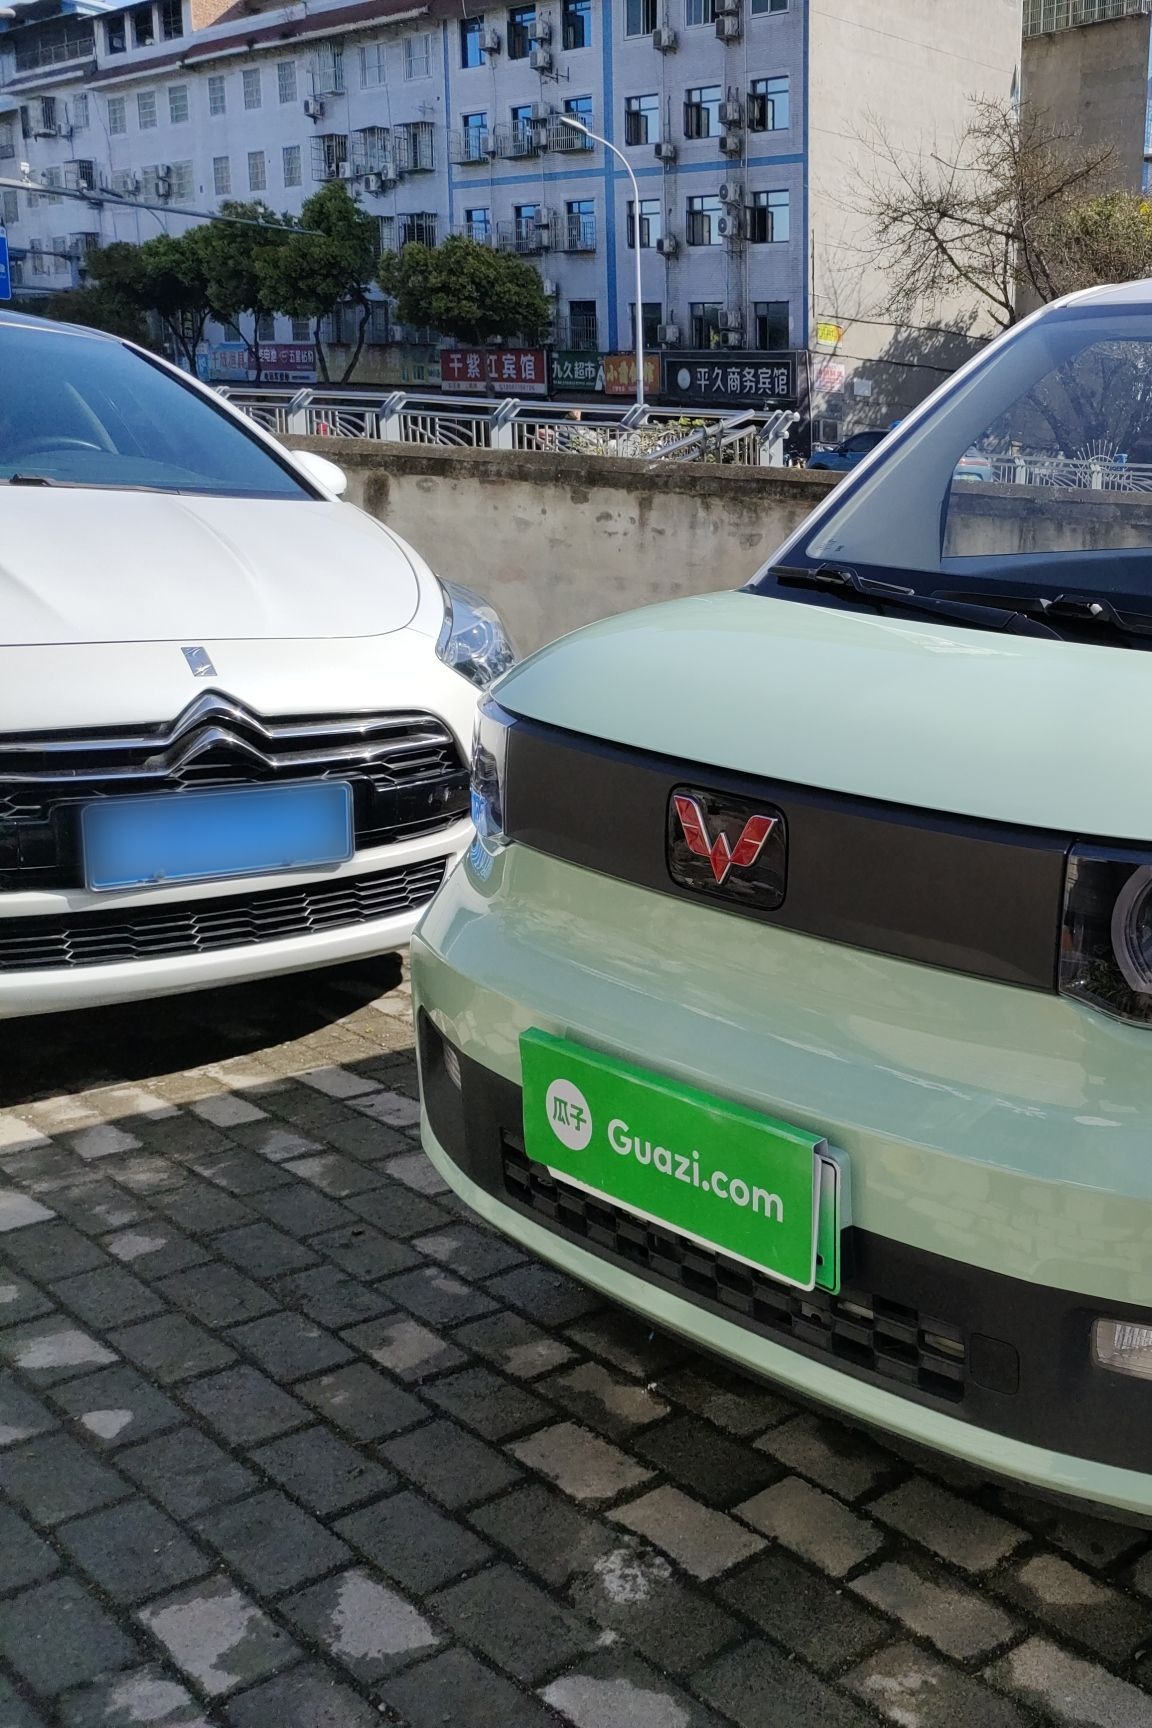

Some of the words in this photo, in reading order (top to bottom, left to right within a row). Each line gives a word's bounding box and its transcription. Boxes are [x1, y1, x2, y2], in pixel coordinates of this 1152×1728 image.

[552, 360, 596, 379] 九久超市
[696, 367, 788, 394] 平久商务宾馆
[553, 1096, 587, 1132] 瓜子
[607, 1118, 785, 1223] Guazi.com
